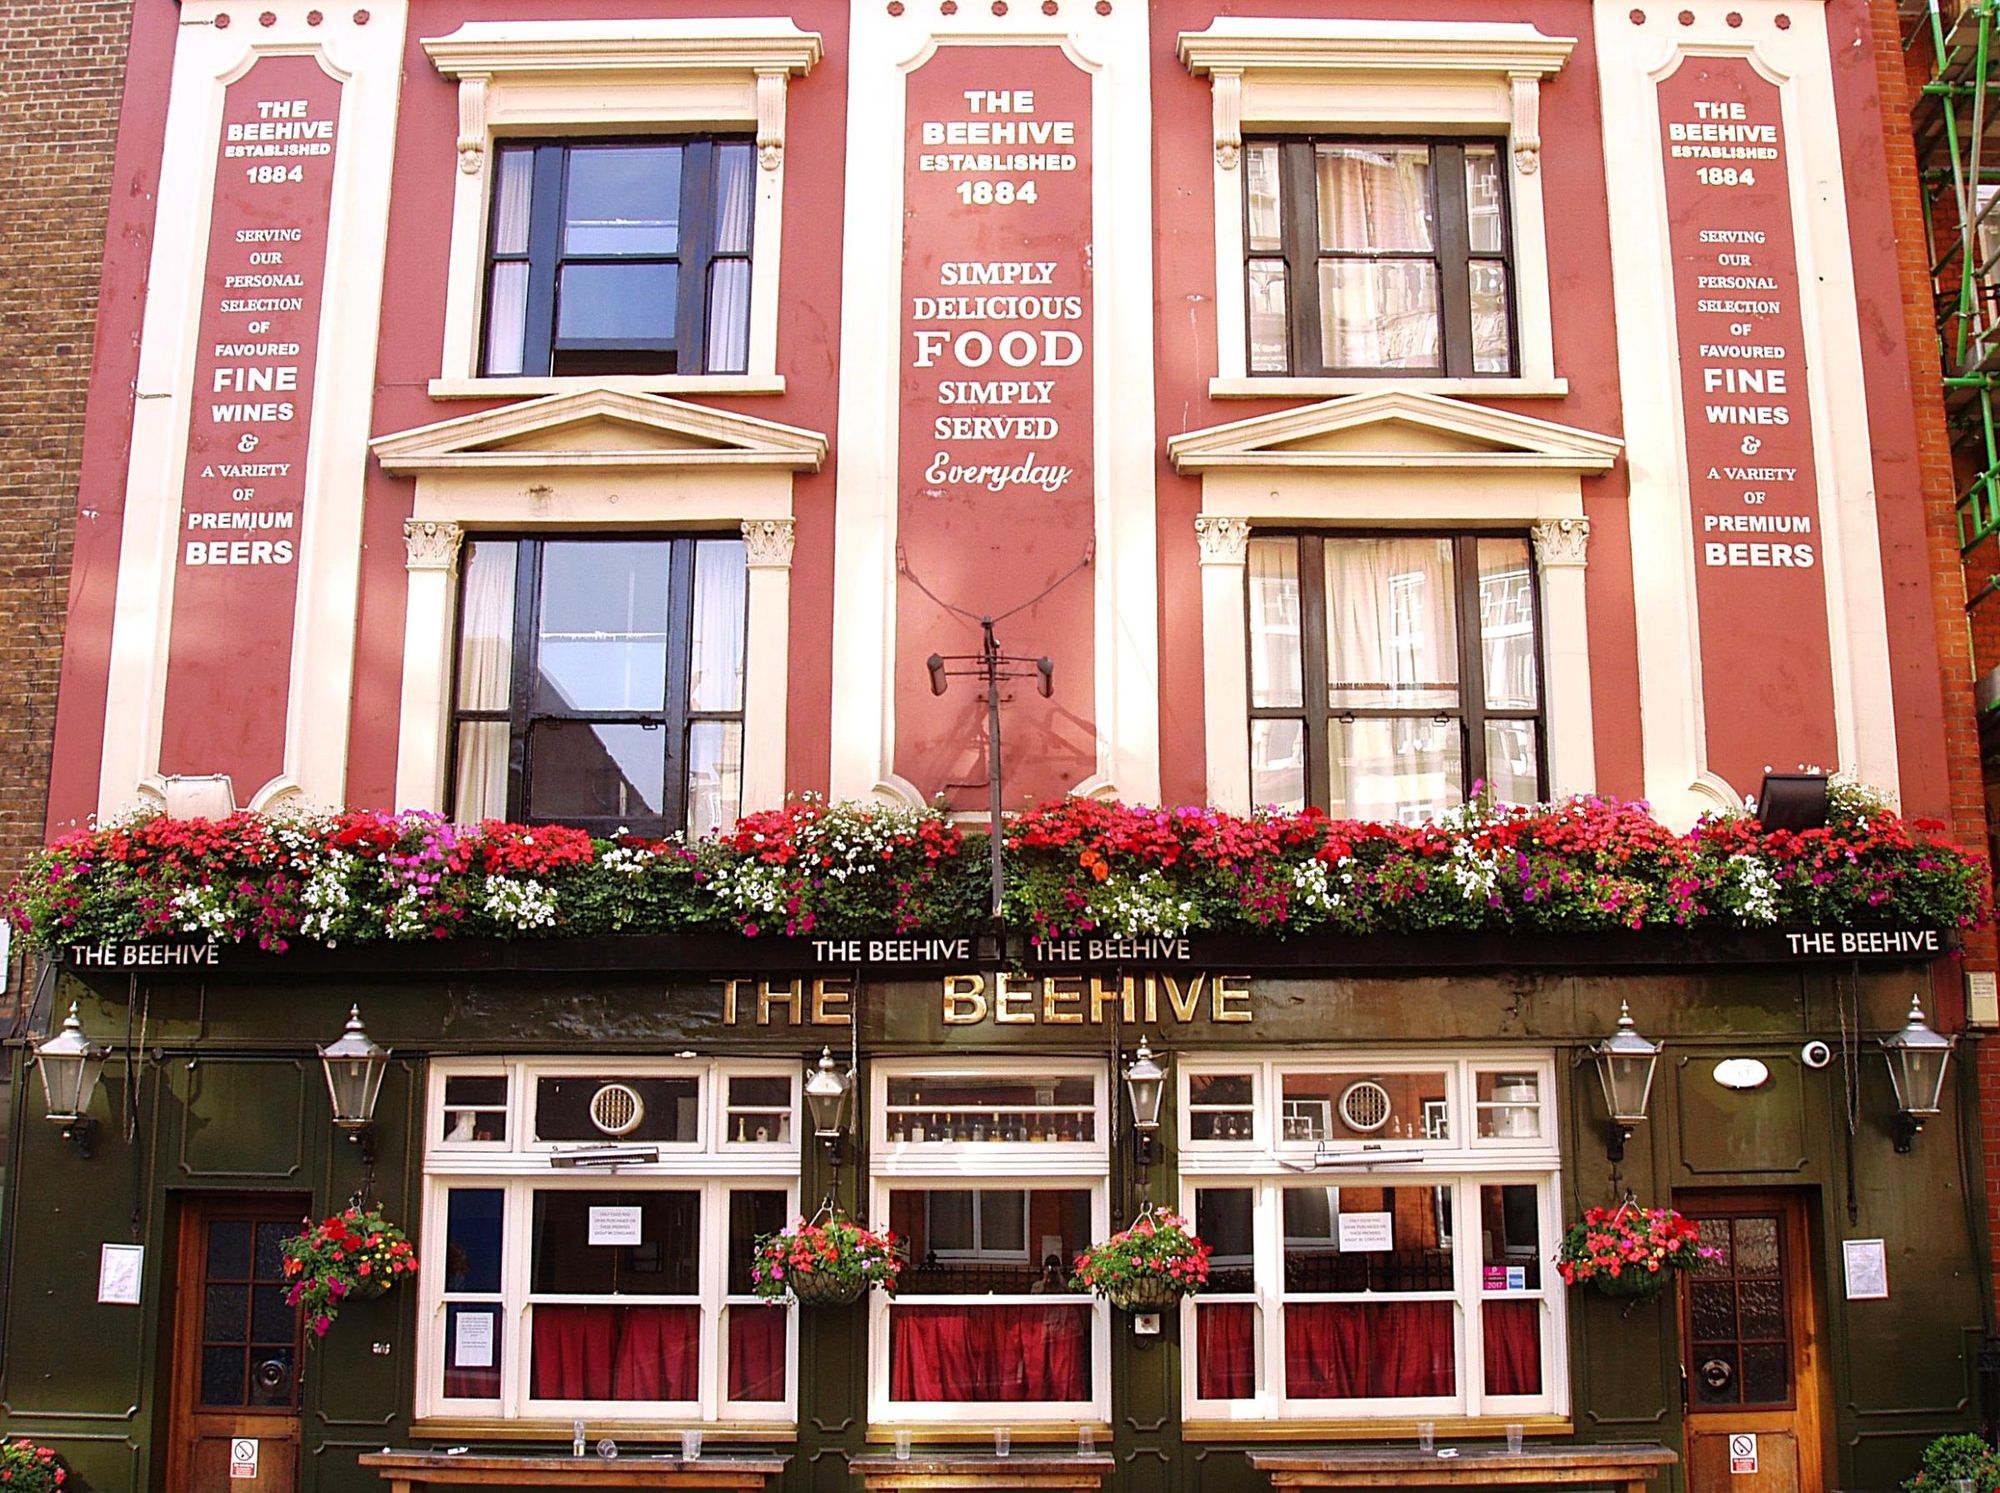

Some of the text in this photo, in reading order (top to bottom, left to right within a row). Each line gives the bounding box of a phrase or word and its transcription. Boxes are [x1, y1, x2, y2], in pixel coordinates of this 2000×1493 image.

[258, 100, 308, 118] THE
[964, 91, 1034, 113] THE
[1694, 102, 1746, 119] THE
[227, 121, 333, 141] BEEHIVE
[921, 121, 1075, 145] BEEHIVE
[1669, 124, 1777, 142] BEEHIVE
[225, 143, 330, 157] ESTABLISHED
[1672, 146, 1777, 159] ESTABLISHED
[920, 153, 1076, 172] ESTABLISHED
[247, 165, 303, 183] 1884
[1697, 168, 1755, 185] 1884
[955, 180, 1038, 205] 1884
[236, 229, 301, 242] SERVING
[1700, 231, 1765, 243] SERVING
[250, 252, 282, 264] OUR
[1719, 254, 1751, 266] OUR
[225, 274, 303, 287] PERSONAL
[941, 263, 1057, 286] SIMPLY
[1698, 277, 1777, 289] PERSONAL
[221, 298, 303, 312] SELECTION
[913, 296, 1081, 319] DELICIOUS
[1698, 300, 1780, 314] SELECTION
[248, 322, 270, 333] OF
[1730, 324, 1751, 335] OF
[215, 344, 299, 356] FAVOURED
[913, 331, 1082, 367] FOOD
[1700, 345, 1785, 358] FAVOURED
[214, 367, 297, 392] FINE
[1704, 369, 1786, 393] FINE
[939, 381, 1055, 404] SIMPLY
[212, 403, 293, 422] WINES
[1706, 406, 1789, 424] WINES
[935, 416, 1058, 439] SERVED
[238, 434, 258, 452] &
[1741, 436, 1761, 454] &
[201, 464, 290, 477] A VARIETY
[1707, 468, 1796, 480] A VARIETY
[233, 489, 254, 500] OF
[1744, 492, 1765, 503] OF
[188, 512, 293, 530] PREMIUM
[1705, 516, 1810, 532] PREMIUM
[186, 540, 292, 565] BEERS
[1705, 543, 1813, 567] BEERS
[812, 940, 969, 961] THE BEEHIVE
[1036, 939, 1190, 961] THE BEEHIVE
[1786, 931, 1938, 953] THE BEEHIVE
[72, 944, 219, 966] THE BEEHIVE
[709, 972, 1253, 1025] THE BEEHIVE
[1487, 1281, 1503, 1289] 2017
